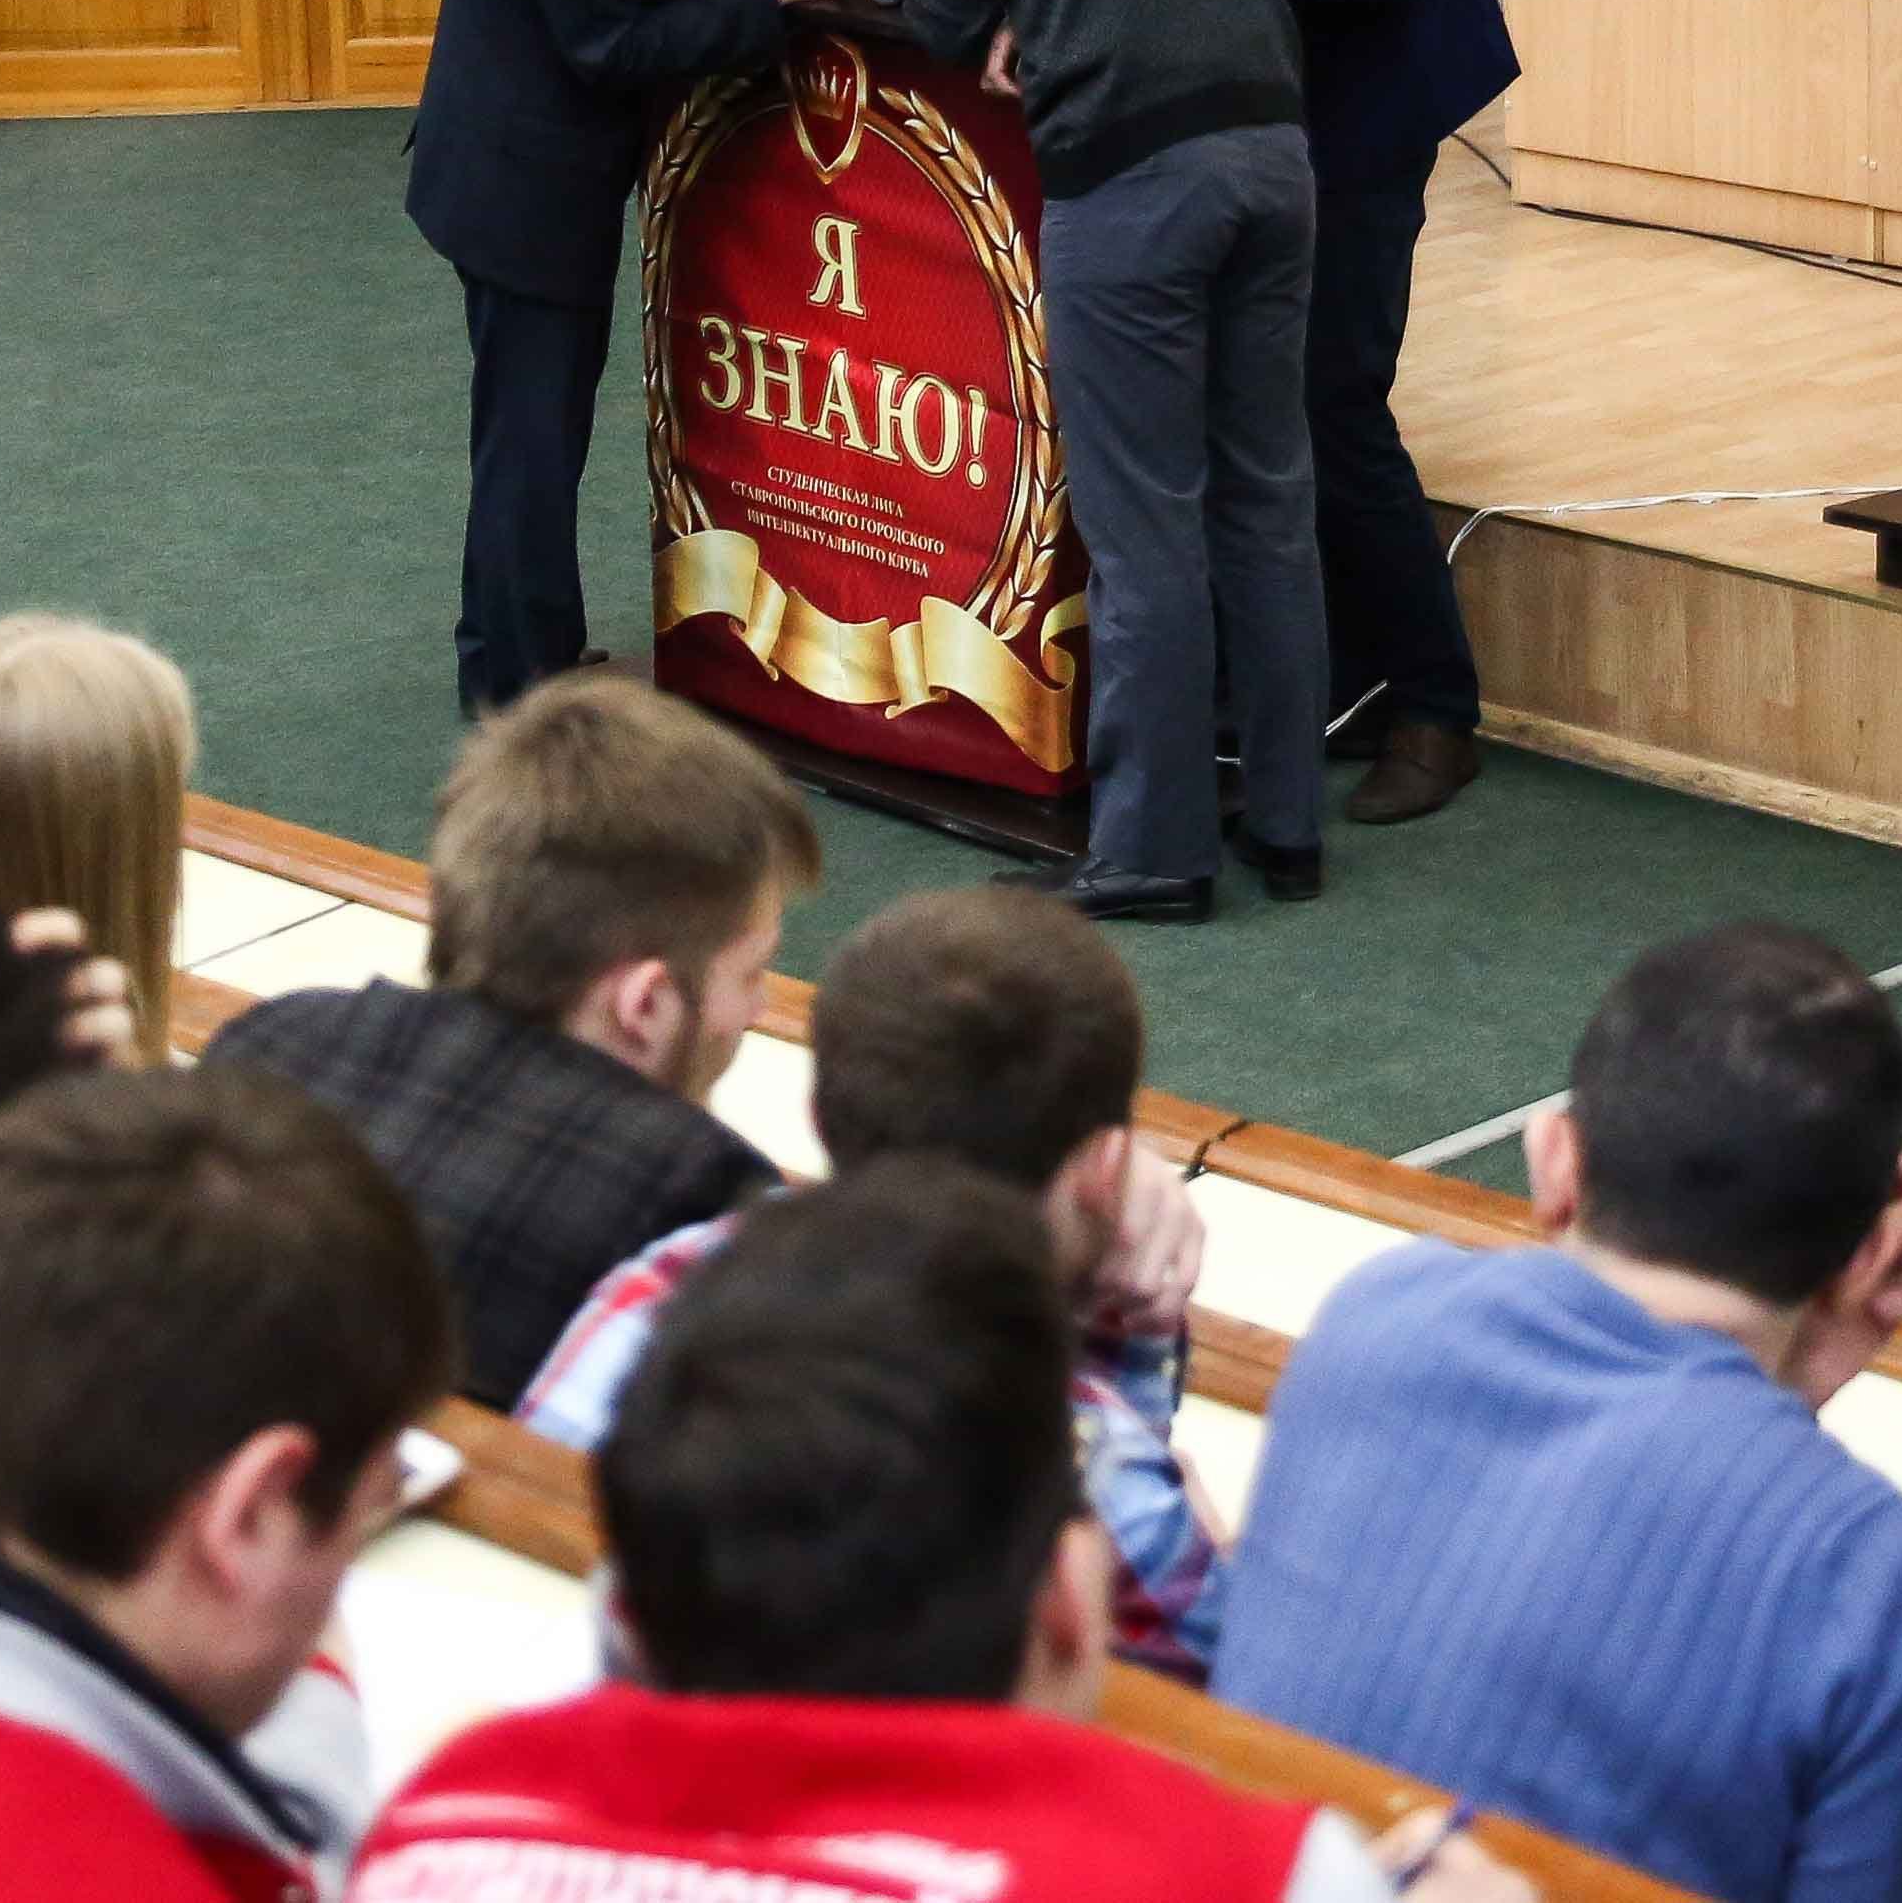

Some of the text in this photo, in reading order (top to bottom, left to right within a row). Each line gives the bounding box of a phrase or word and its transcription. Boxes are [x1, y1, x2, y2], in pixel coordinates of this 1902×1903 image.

[807, 212, 866, 319] Я
[697, 312, 991, 490] ЗНАЮ!
[731, 481, 945, 556] СТАВРОПОЛЬСКОГО ГОРОДСКОГО
[767, 465, 904, 519] СТУДЕНЧЕСКАЯ ЛИГА
[747, 508, 930, 579] ИНТЕЛЛЕКТУАЛЬНОГО КЛУБА
